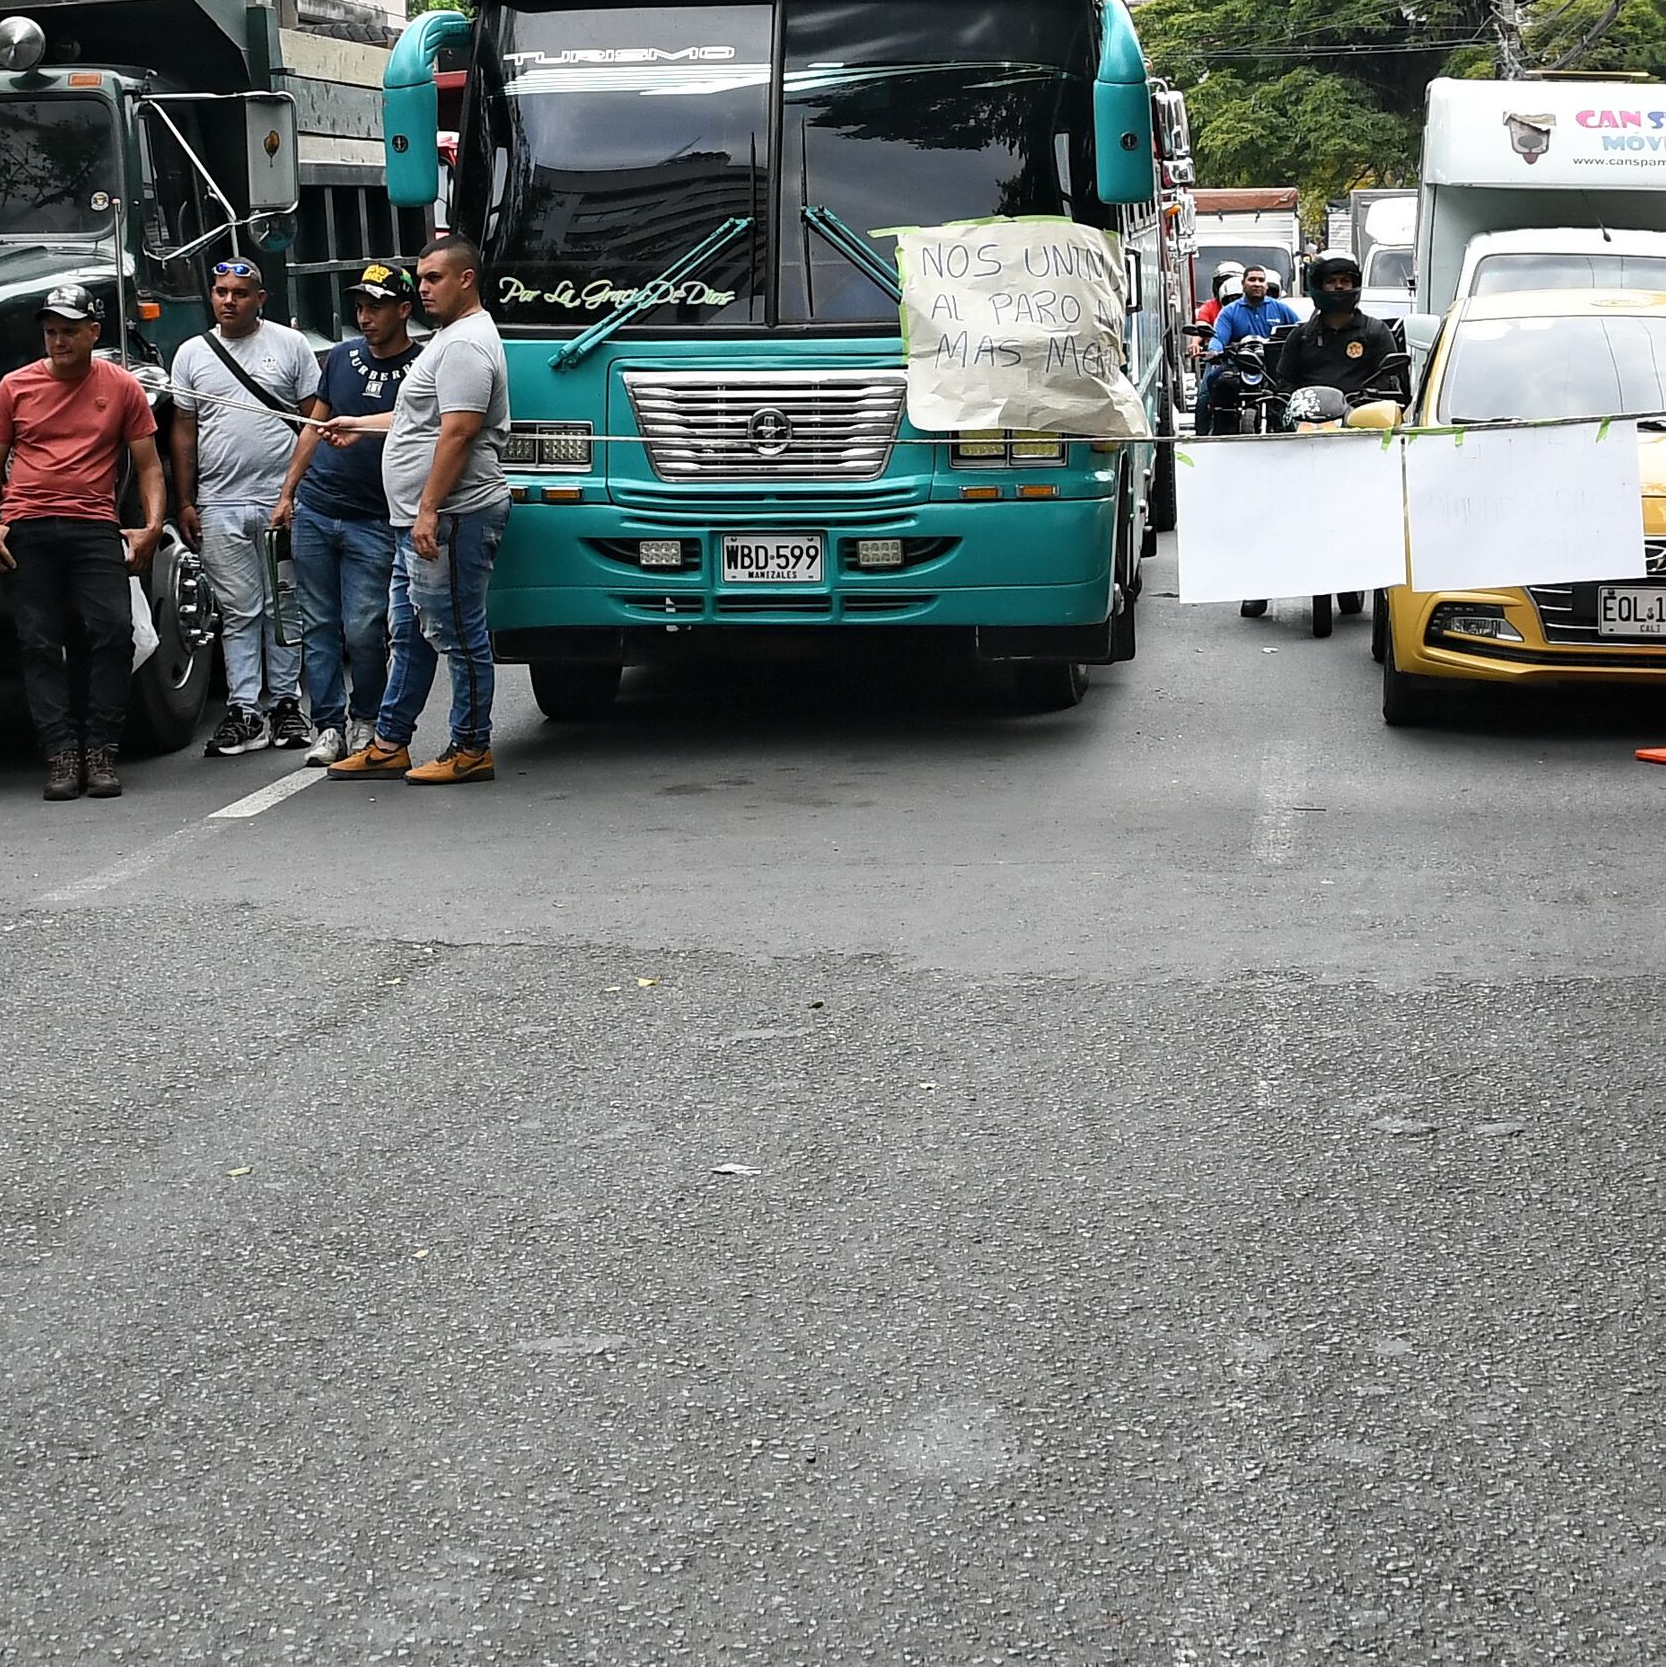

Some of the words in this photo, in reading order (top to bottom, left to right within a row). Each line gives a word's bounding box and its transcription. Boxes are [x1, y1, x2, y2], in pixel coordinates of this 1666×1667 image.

[503, 45, 736, 66] TURISMO
[1575, 109, 1642, 129] CAN
[921, 243, 1002, 279] NOS
[498, 276, 542, 306] Por
[543, 280, 582, 308] La
[681, 280, 736, 307] Dios
[988, 290, 1082, 324] PARO
[934, 330, 1022, 370] MAS
[748, 571, 798, 580] MANIZALES
[1639, 624, 1662, 633] CALI
